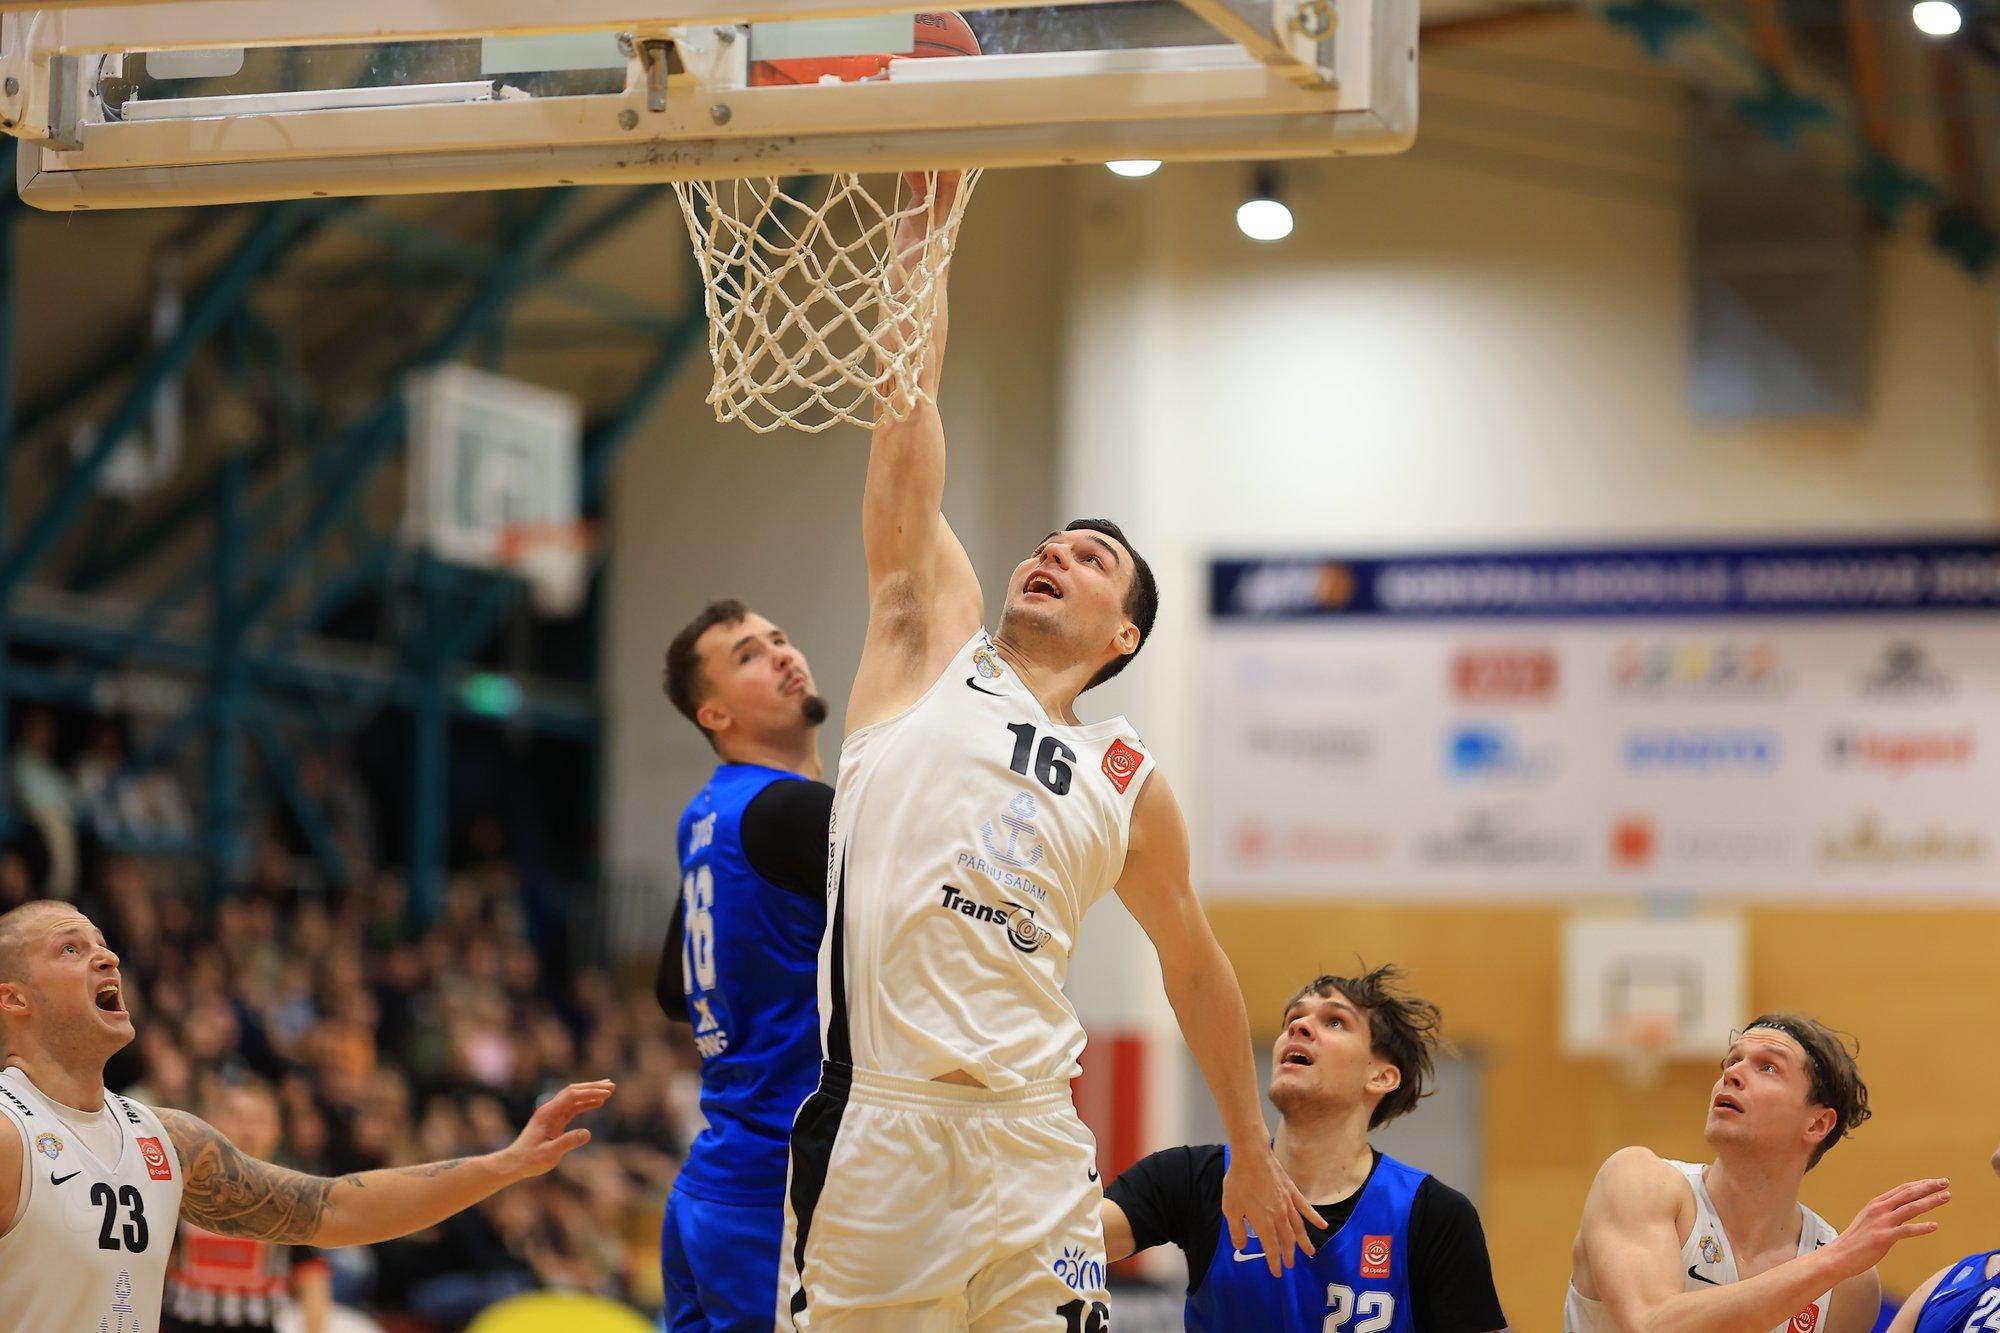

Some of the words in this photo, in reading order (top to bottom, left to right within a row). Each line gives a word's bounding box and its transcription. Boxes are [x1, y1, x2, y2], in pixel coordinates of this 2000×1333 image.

[1007, 723, 1077, 796] 16
[1004, 873, 1047, 901] SADAM
[91, 1183, 149, 1253] 23
[1056, 1299, 1109, 1333] 16
[1322, 1283, 1395, 1333] 22
[1963, 1287, 2000, 1333] 2
